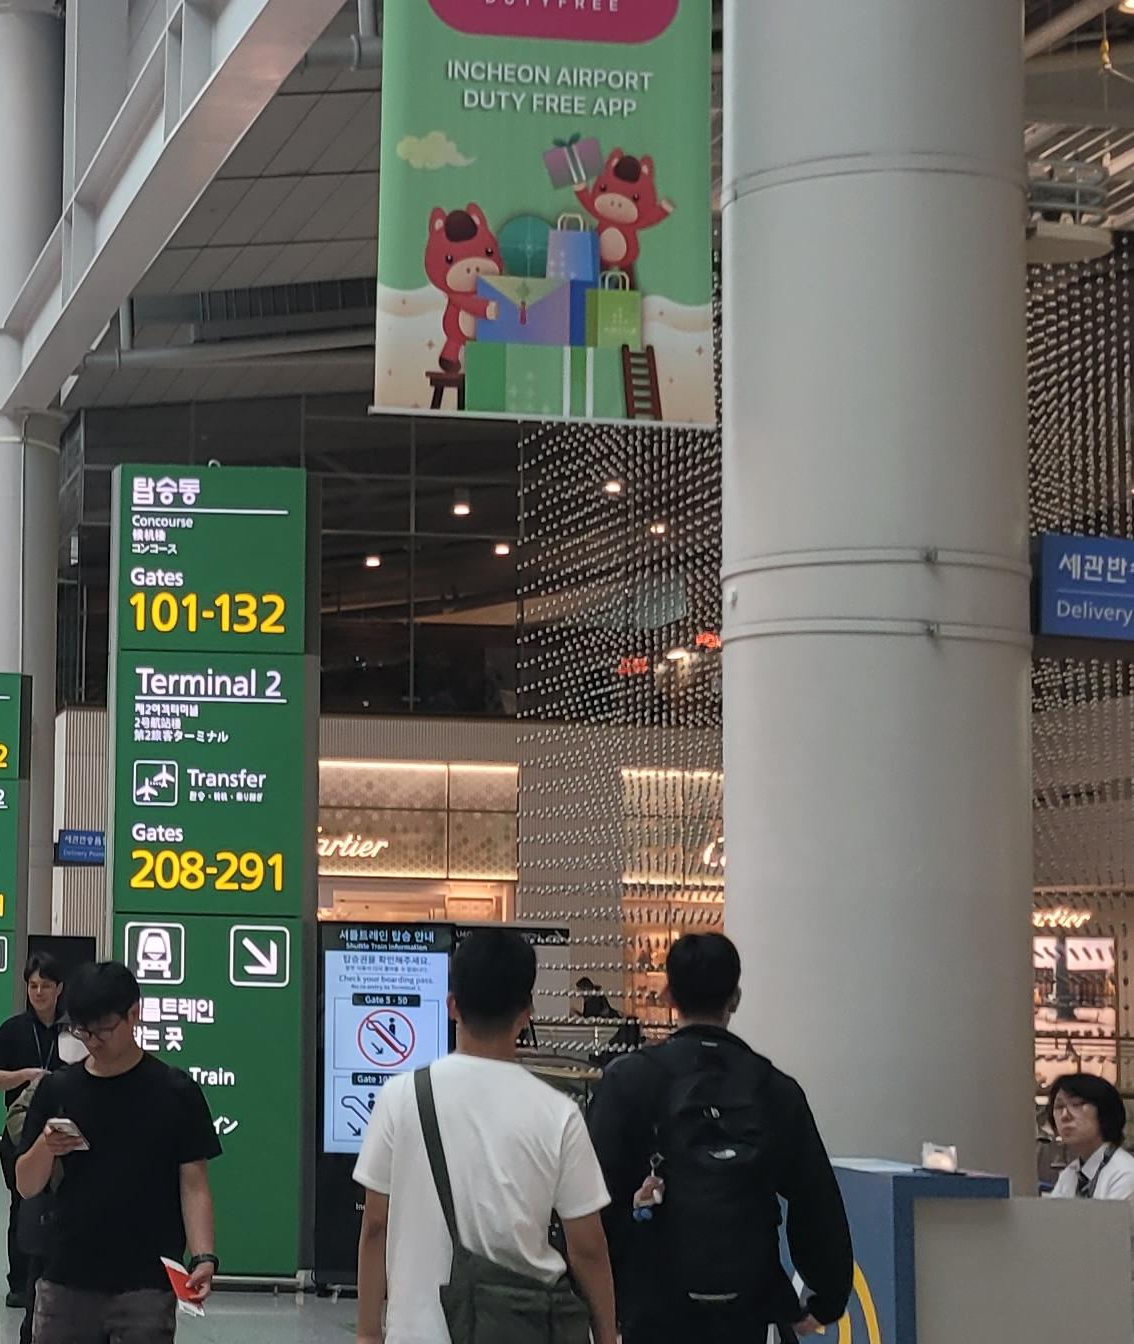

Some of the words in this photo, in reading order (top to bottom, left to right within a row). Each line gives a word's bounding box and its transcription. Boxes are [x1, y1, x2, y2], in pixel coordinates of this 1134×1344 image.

[447, 60, 550, 84] INCHEON
[556, 67, 653, 92] AIRPORT
[463, 89, 526, 111] DUTY
[533, 93, 586, 115] FREE
[592, 97, 637, 118] APP
[133, 476, 200, 505] 탑승동
[132, 514, 193, 528] Concourse
[132, 543, 177, 554] コンコース
[130, 567, 184, 586] Gates
[1058, 554, 1134, 584] 세관반
[129, 591, 285, 634] 101-132
[1057, 600, 1133, 627] Delivery
[135, 668, 256, 697] Terminal
[265, 670, 281, 697] 2
[186, 768, 266, 788] Transfer
[131, 822, 183, 843] Gates
[317, 831, 389, 857] artier
[129, 849, 284, 893] 208-291
[339, 928, 388, 943] 셔틀트레인
[414, 930, 434, 944] 안내
[346, 942, 369, 950] Shuttle
[371, 942, 387, 951] Train
[388, 943, 427, 951] Information
[339, 975, 361, 983] Check
[363, 977, 380, 985] your
[381, 975, 414, 985] boarding
[139, 997, 214, 1023] 틀트레인
[365, 996, 384, 1004] Gate
[398, 996, 408, 1005] 50
[165, 1026, 183, 1051] 곳
[189, 1067, 235, 1086] Train
[357, 1075, 377, 1084] Gate
